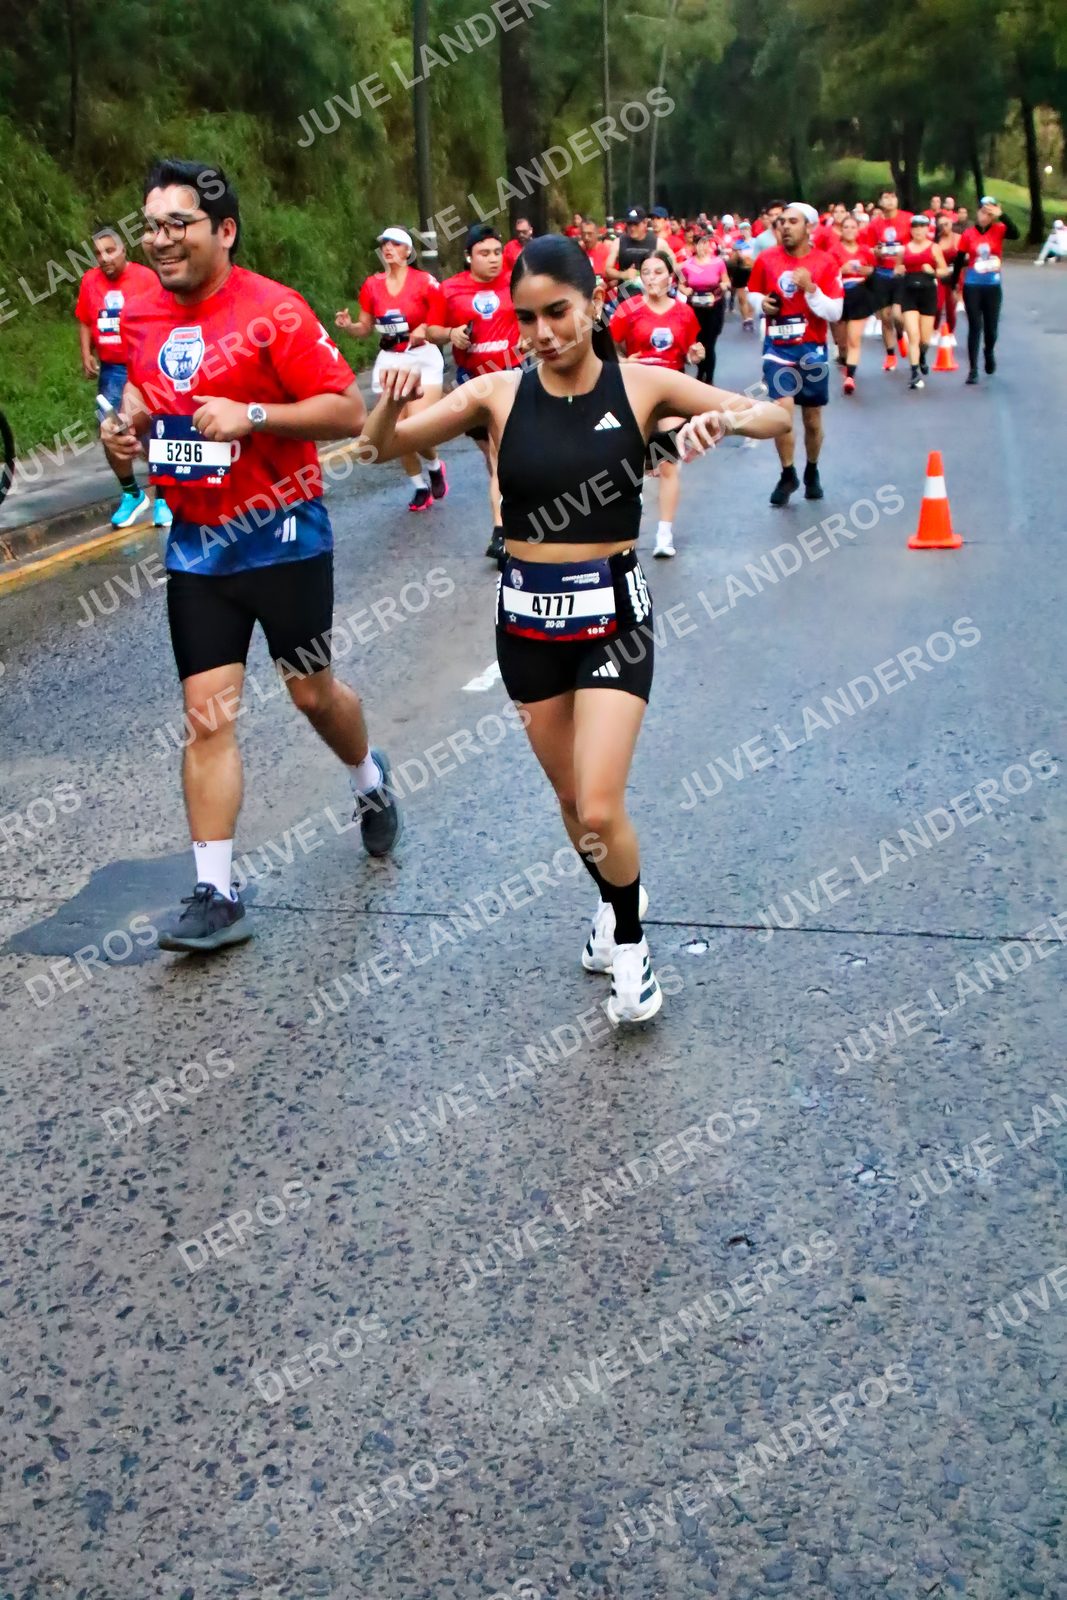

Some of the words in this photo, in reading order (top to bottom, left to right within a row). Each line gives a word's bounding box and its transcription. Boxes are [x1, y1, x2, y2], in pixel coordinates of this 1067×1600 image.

[166, 442, 203, 463] 5296
[532, 594, 575, 616] 4777
[587, 626, 606, 635] 10K
